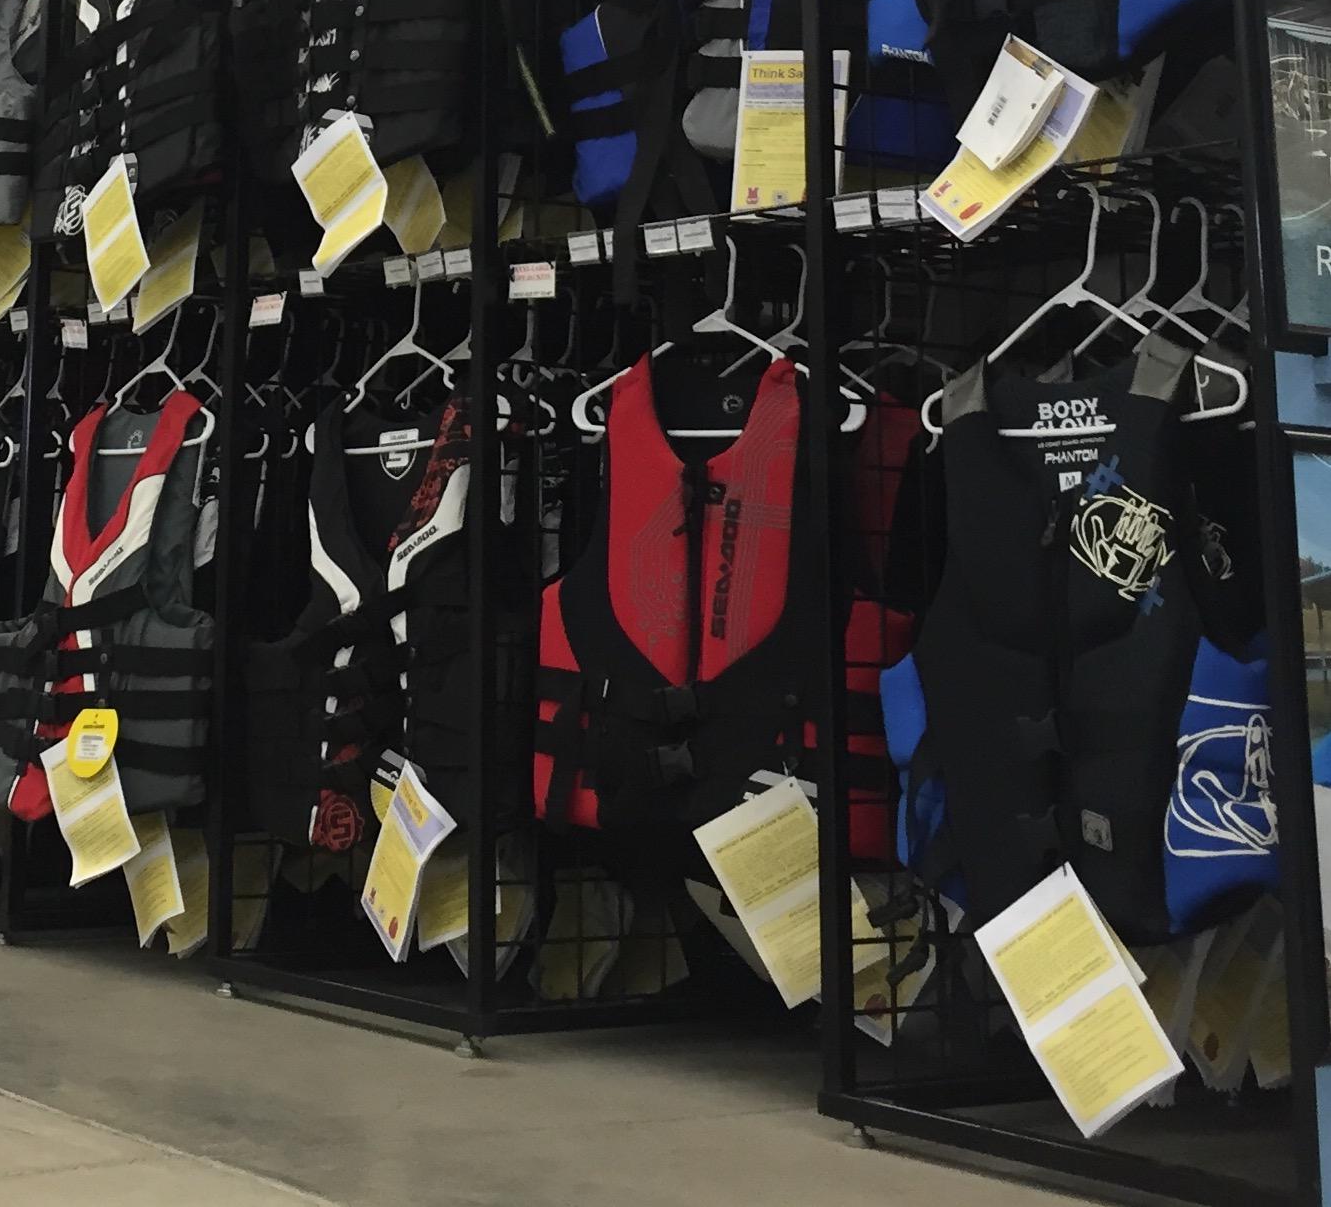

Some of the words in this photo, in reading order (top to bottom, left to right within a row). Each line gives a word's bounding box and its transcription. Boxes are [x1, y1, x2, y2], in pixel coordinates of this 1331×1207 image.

[752, 67, 785, 79] Think
[787, 67, 804, 79] Sa
[1038, 397, 1098, 420] BODY
[1044, 448, 1098, 465] PHANTOM
